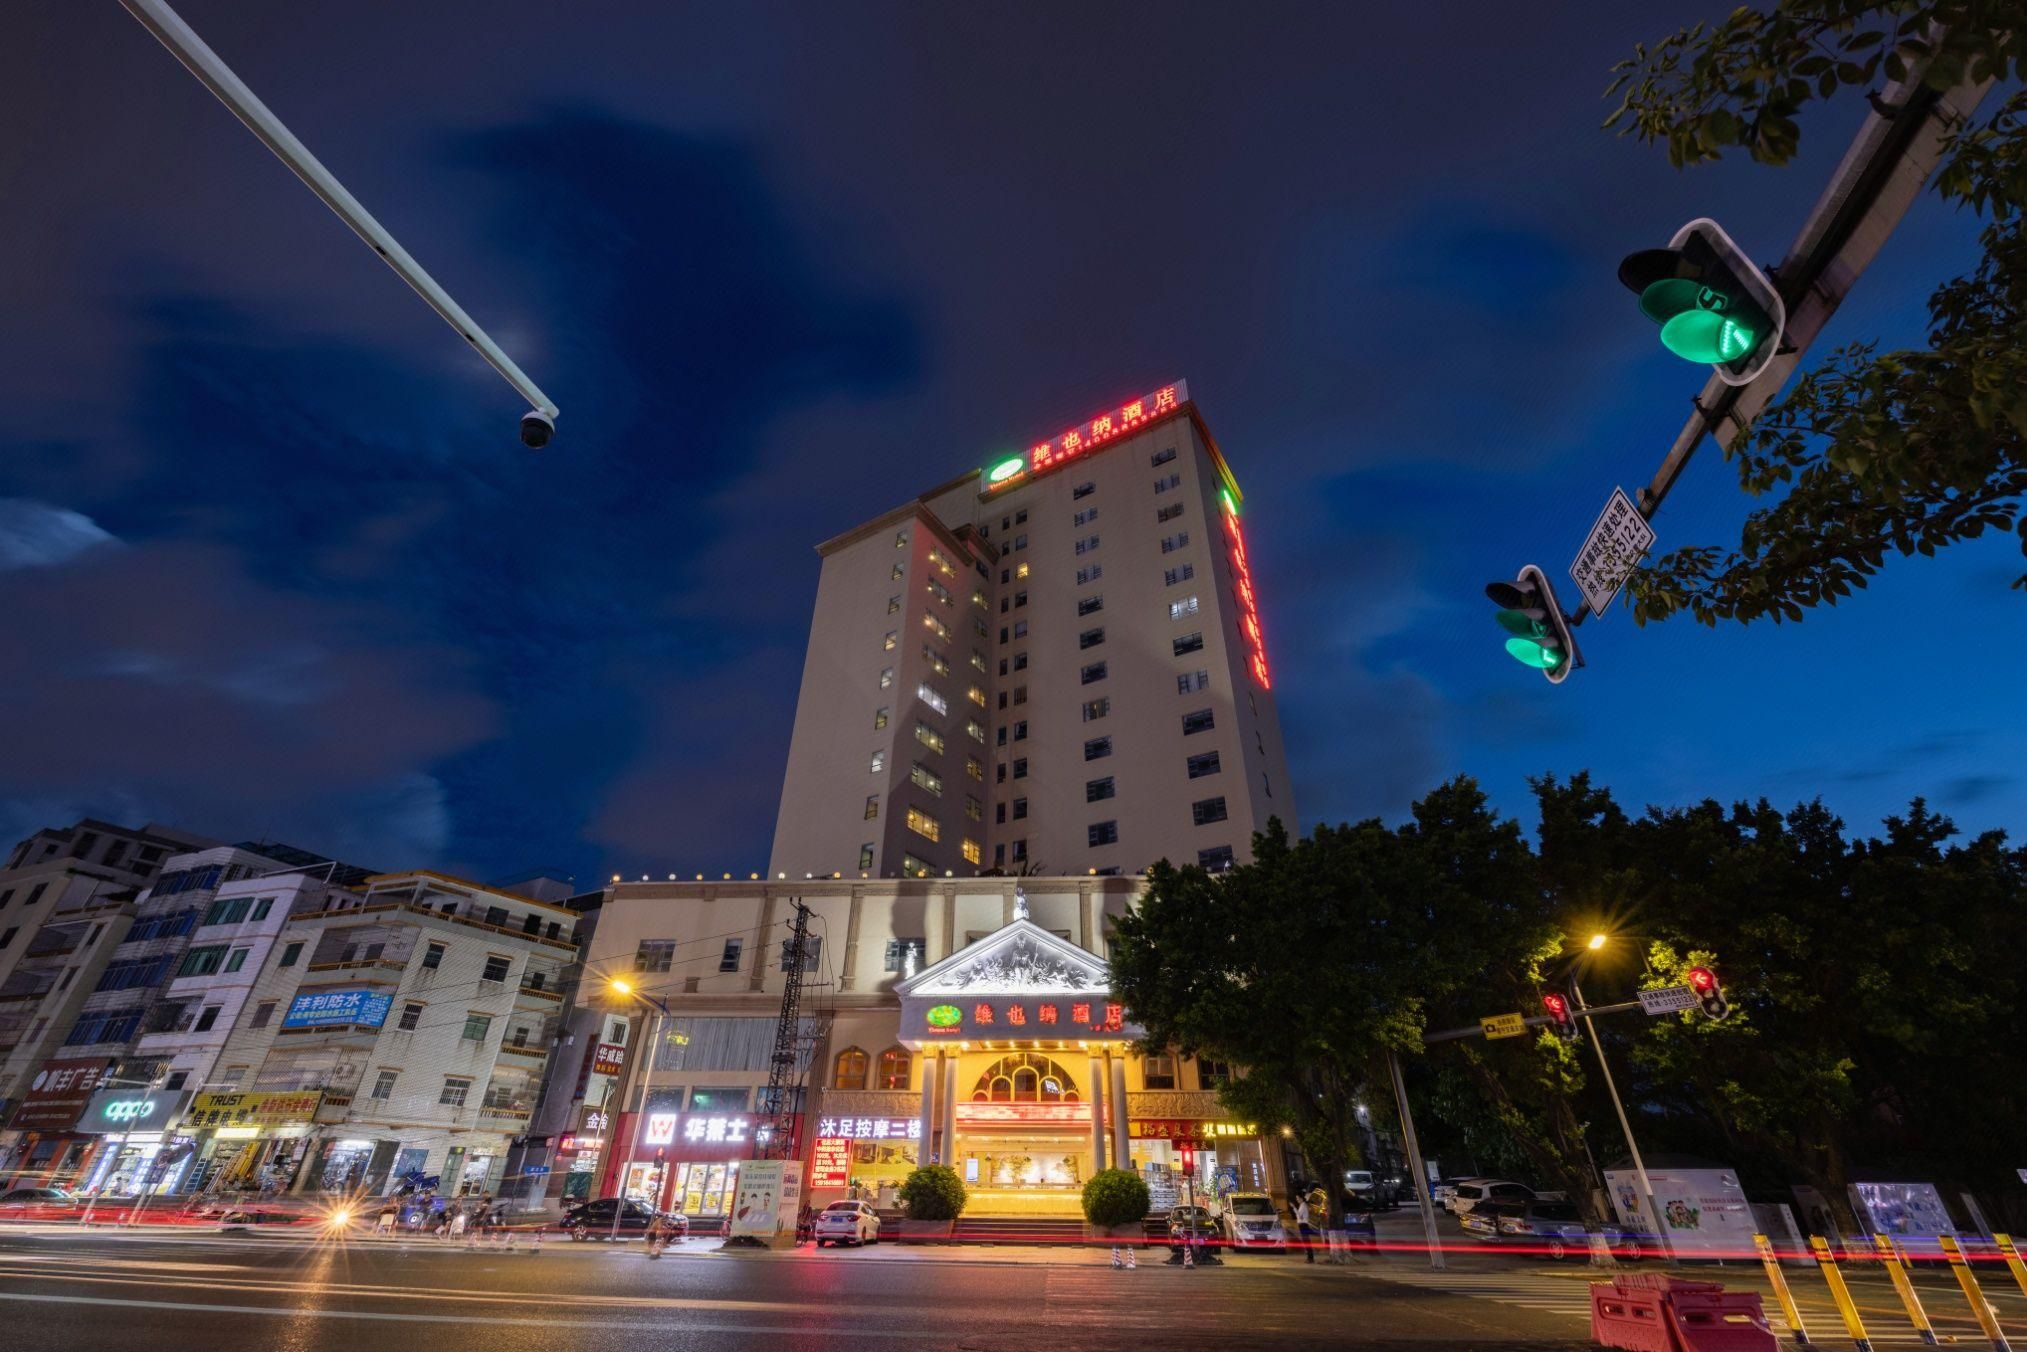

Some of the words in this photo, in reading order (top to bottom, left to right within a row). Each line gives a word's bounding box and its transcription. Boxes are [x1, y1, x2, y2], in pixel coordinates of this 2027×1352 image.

[1033, 387, 1176, 463] 维也纳酒店
[975, 1003, 1122, 1025] 维也纳酒店
[209, 1094, 246, 1106] TRUST
[685, 1118, 748, 1141] 华莱士
[820, 1118, 921, 1138] 沐足按摩二楼
